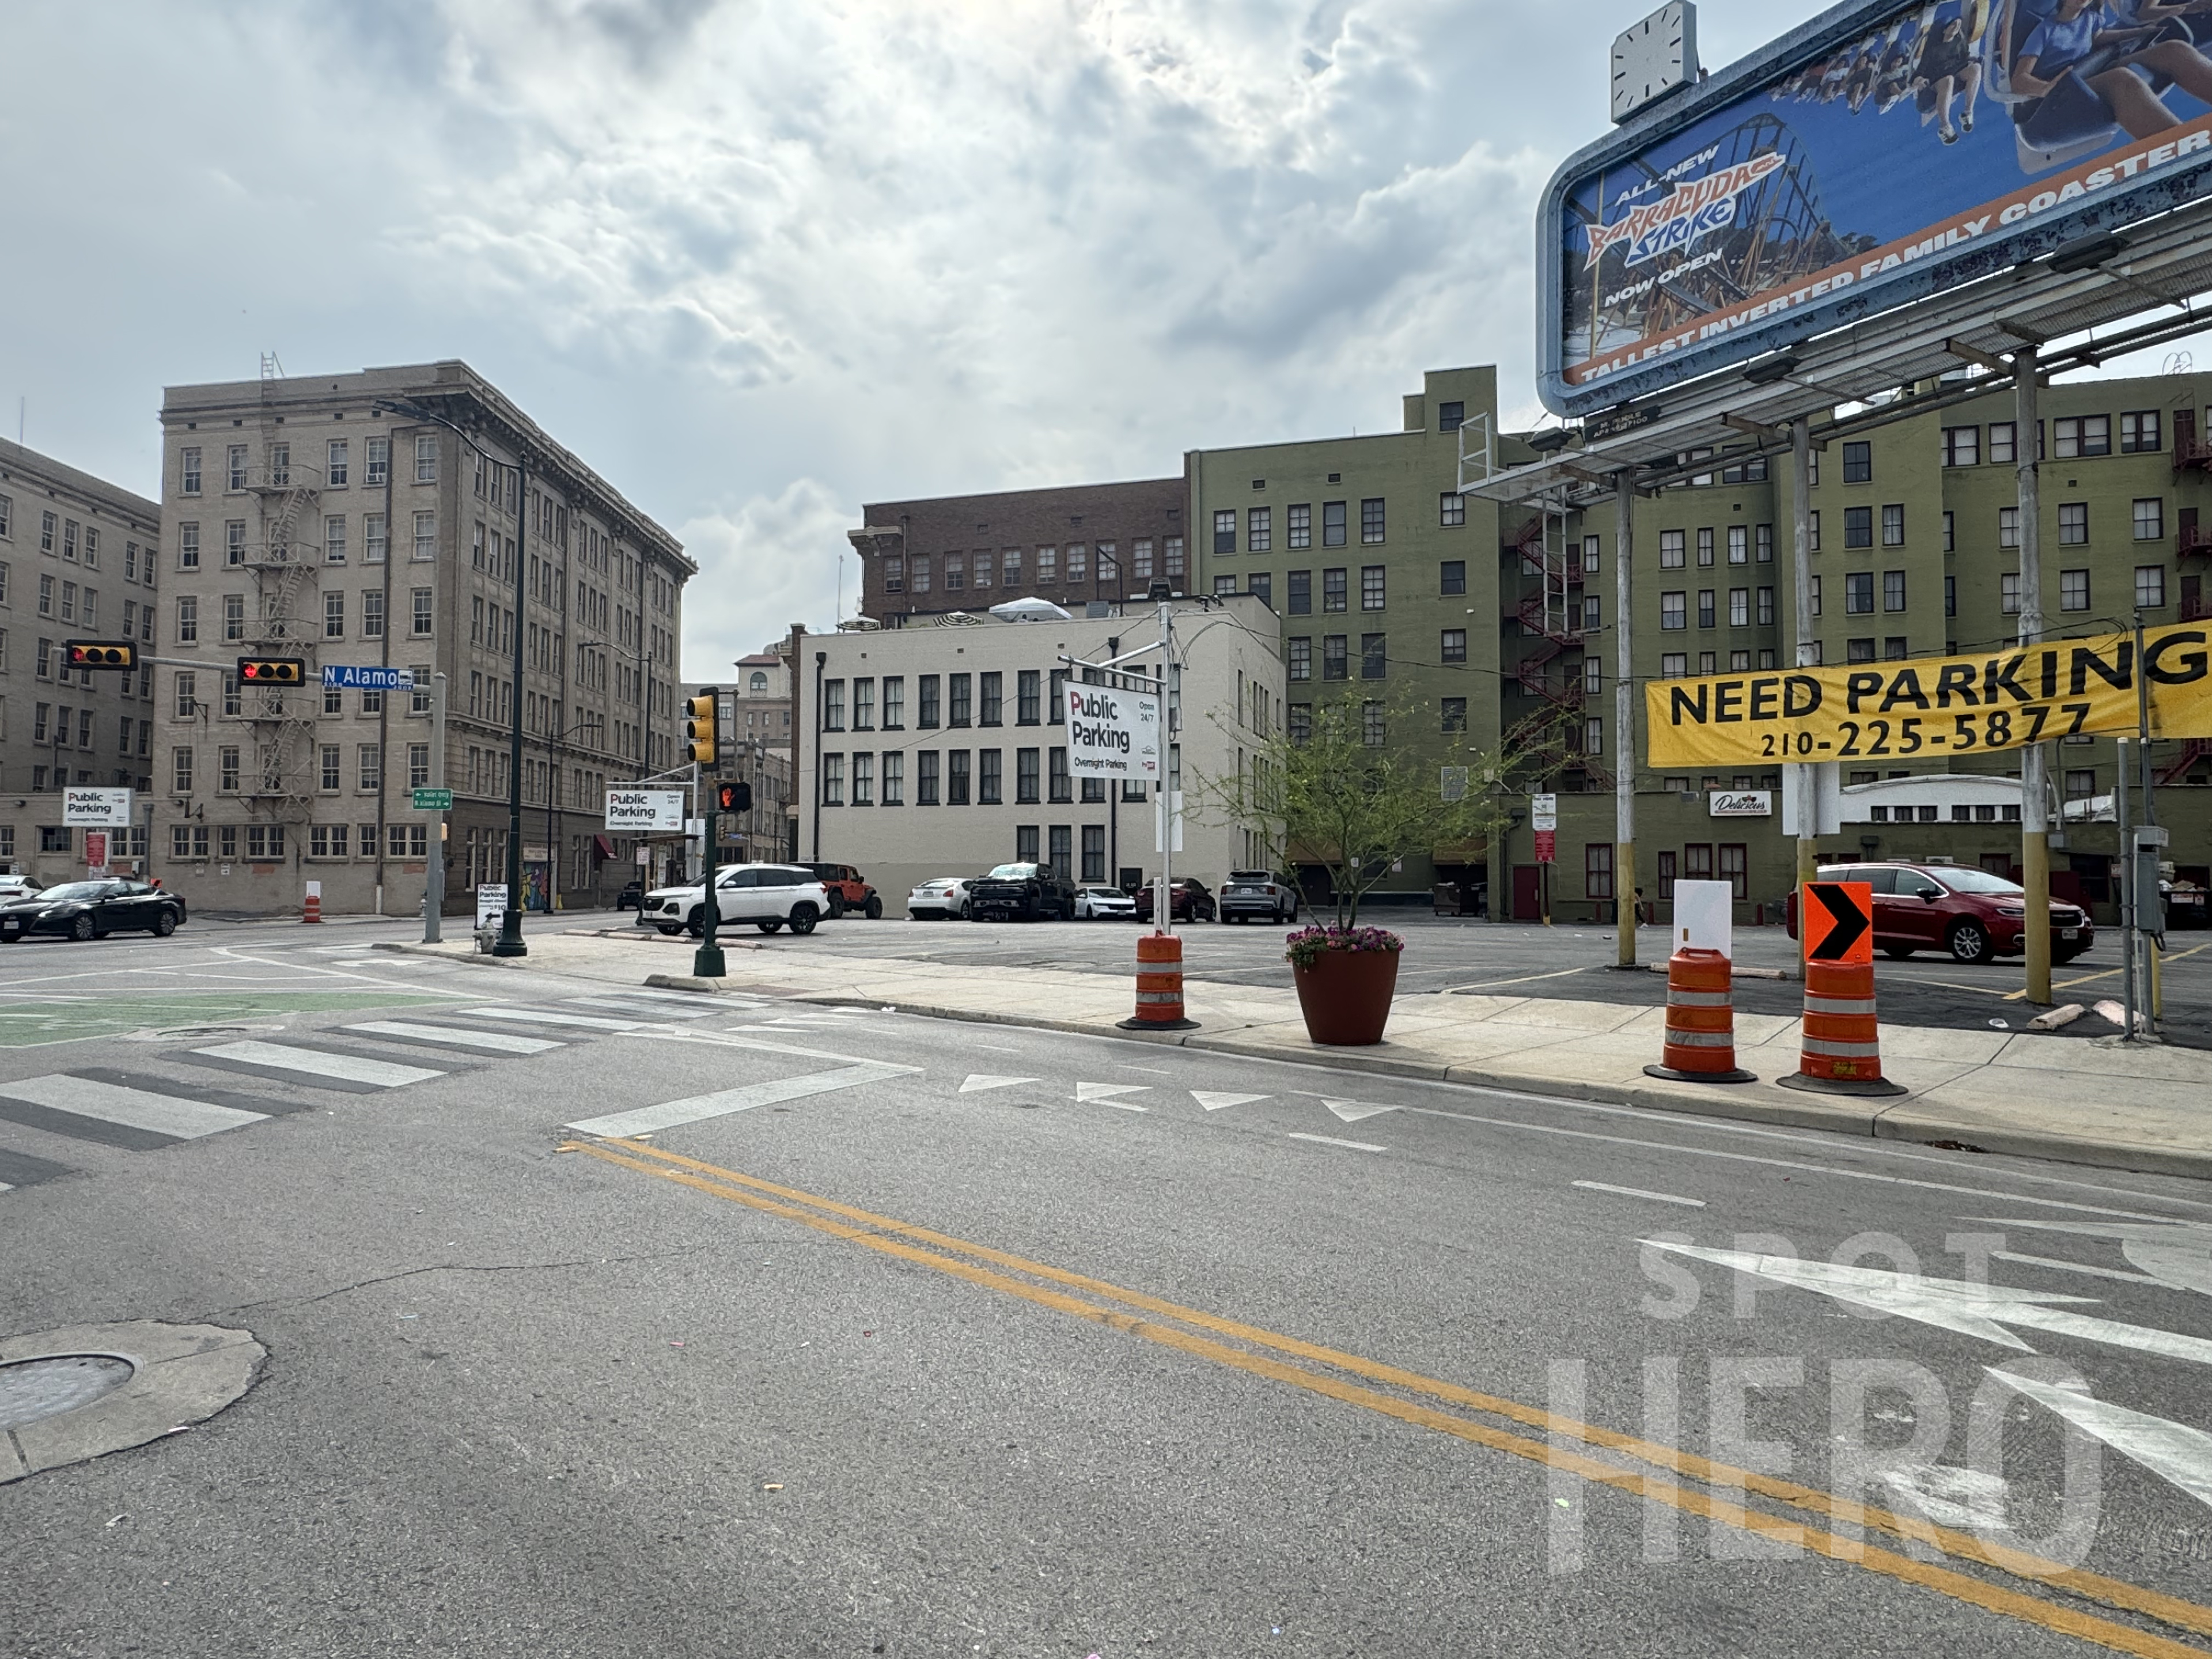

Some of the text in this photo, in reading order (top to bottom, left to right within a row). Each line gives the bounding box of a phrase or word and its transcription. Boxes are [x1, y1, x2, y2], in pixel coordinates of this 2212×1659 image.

[1615, 145, 1719, 206] ALL-NEW
[1585, 160, 1756, 268] BARRACUDA
[1626, 198, 1733, 264] STRIKE
[1581, 130, 2211, 381] TALLEST INVERTED FAMILY COASTER
[1605, 248, 1722, 307] NOW OPEN
[324, 666, 397, 685] N Alamo
[1671, 631, 2209, 725] NEED PARKING
[1070, 691, 1118, 720] Public
[1139, 701, 1154, 711] Open
[1141, 713, 1154, 723] 24/7
[1072, 721, 1130, 754] Parking
[1762, 702, 2092, 756] 210-225-5877
[1074, 756, 1104, 770] Overnight
[1105, 759, 1127, 771] Parking
[68, 804, 111, 814] Parking
[69, 793, 103, 801] Public
[611, 794, 647, 804] Public
[609, 806, 656, 819] Parking
